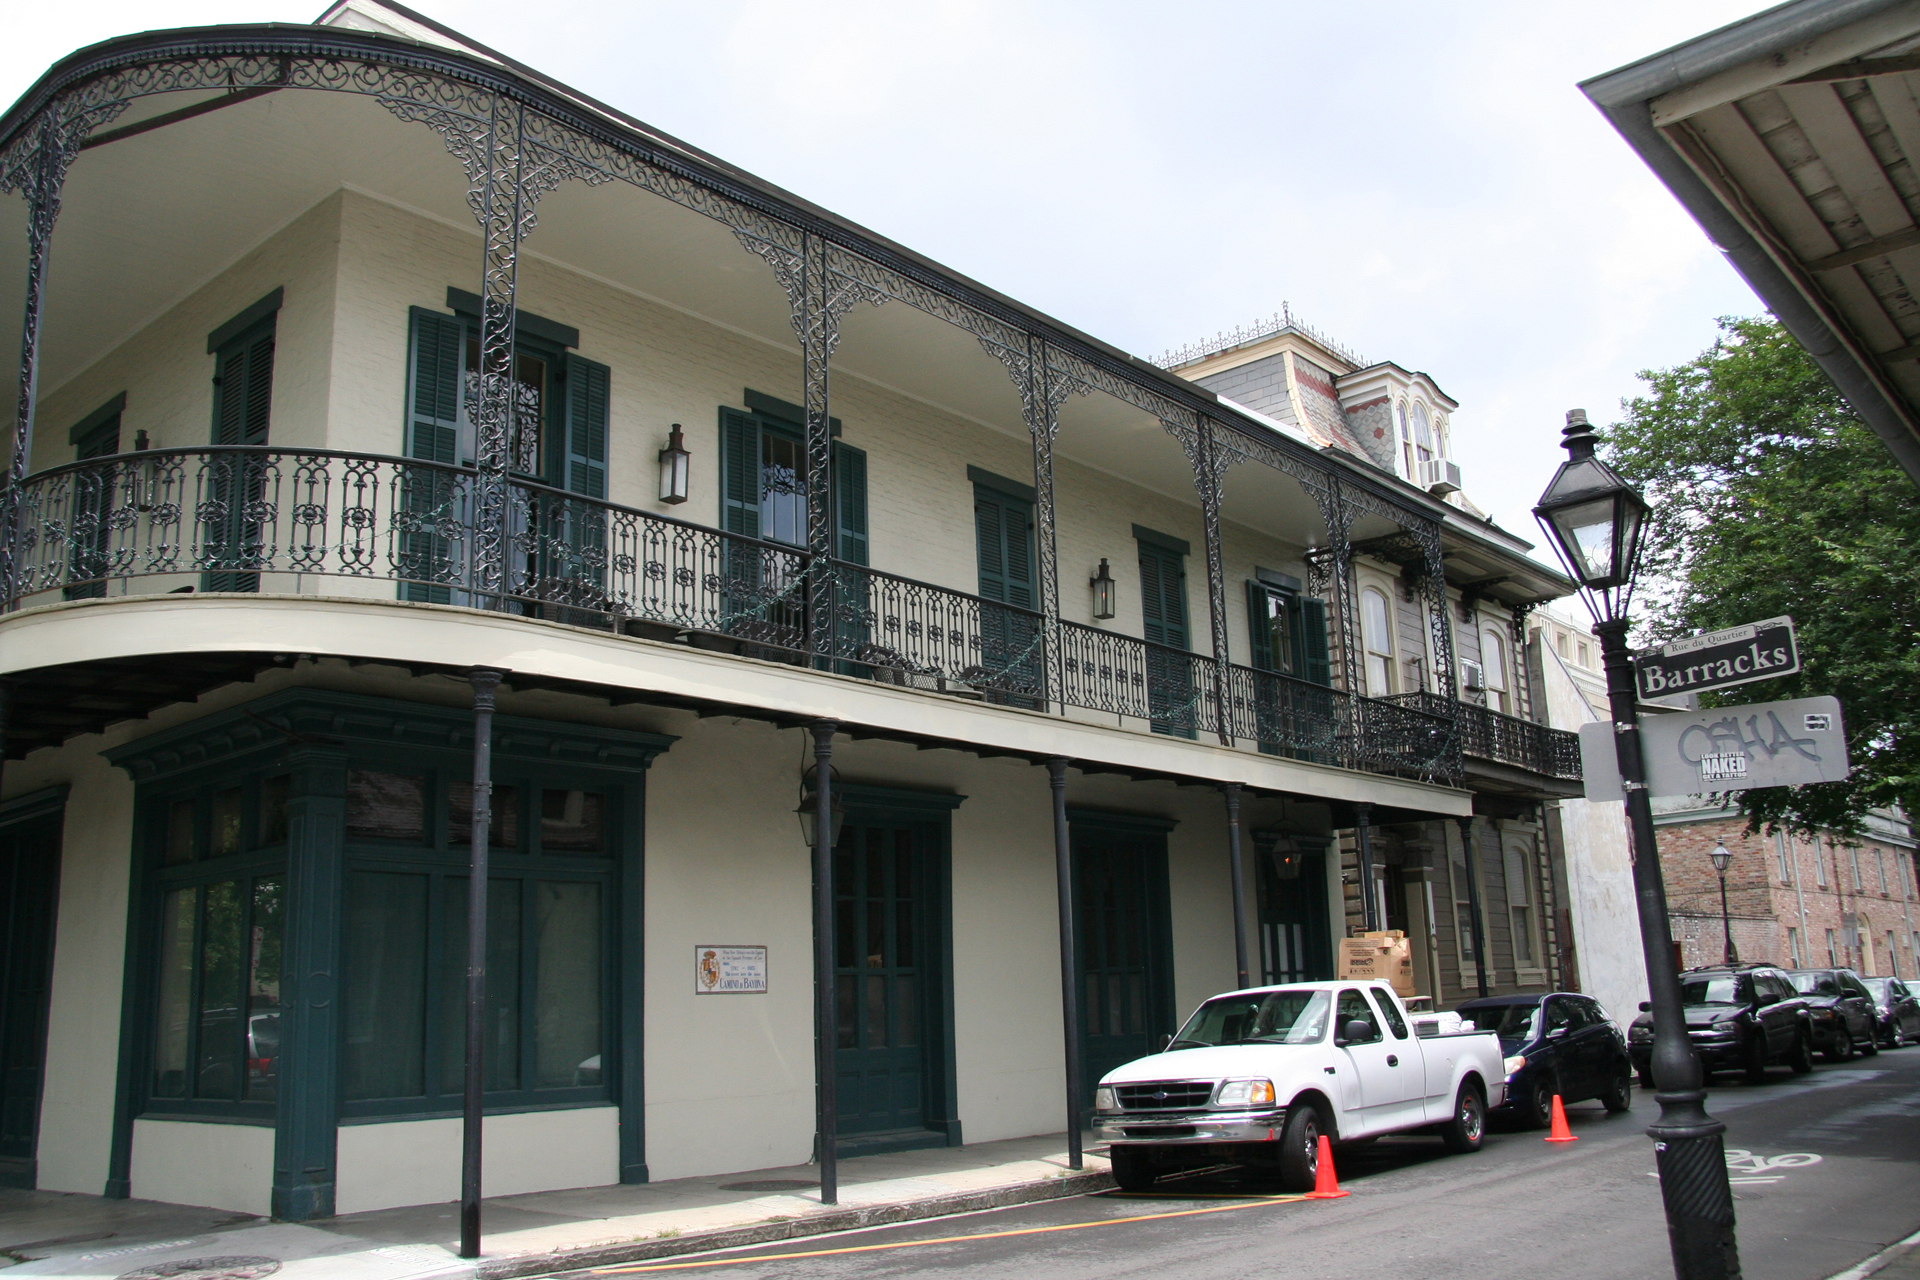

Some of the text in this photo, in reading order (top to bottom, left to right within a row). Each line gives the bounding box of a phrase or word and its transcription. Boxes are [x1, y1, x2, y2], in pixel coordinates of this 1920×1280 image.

[1671, 629, 1748, 653] Rue du Quartier
[1642, 643, 1788, 693] Barracks
[1701, 757, 1746, 774] NAKED
